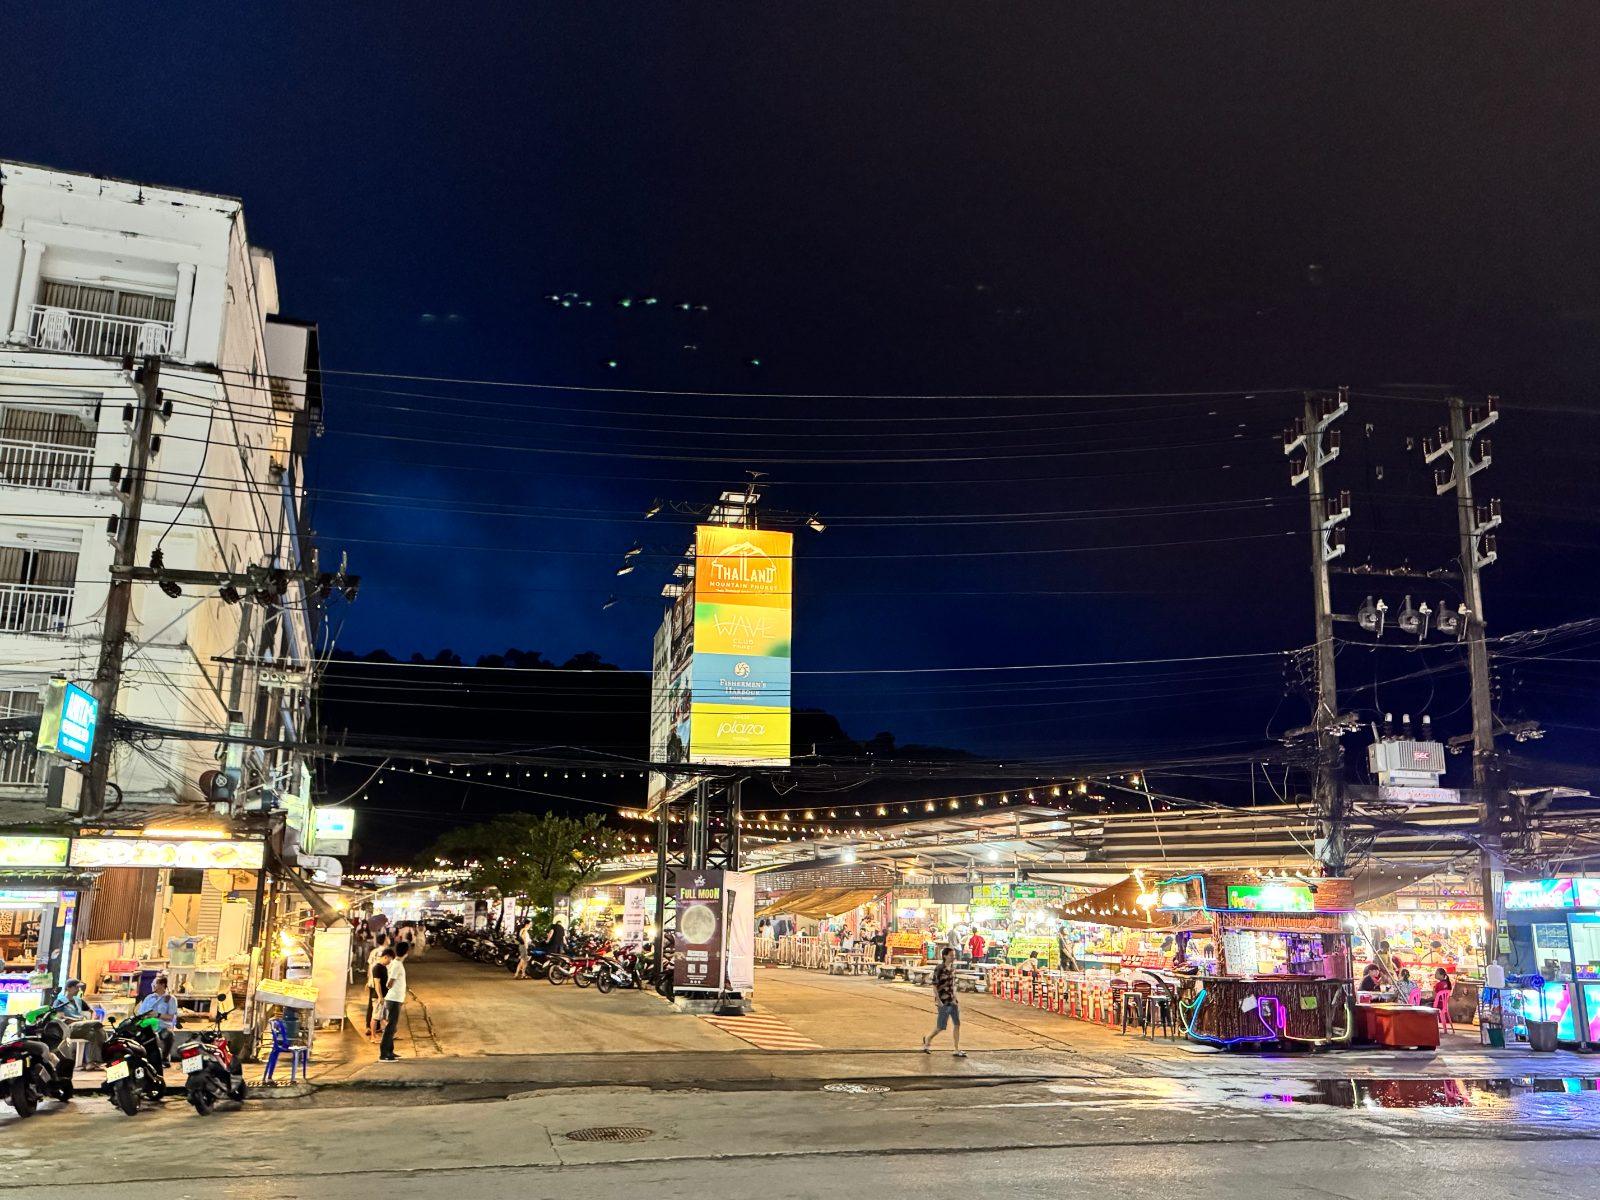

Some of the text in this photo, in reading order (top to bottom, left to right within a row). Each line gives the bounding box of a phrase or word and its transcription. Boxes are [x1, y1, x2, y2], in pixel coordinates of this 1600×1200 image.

[715, 553, 774, 583] THAILAND
[709, 581, 748, 589] MOUNTAIN
[713, 612, 776, 639] WAVE
[716, 720, 767, 738] plaza
[680, 887, 720, 900] FULL MOON
